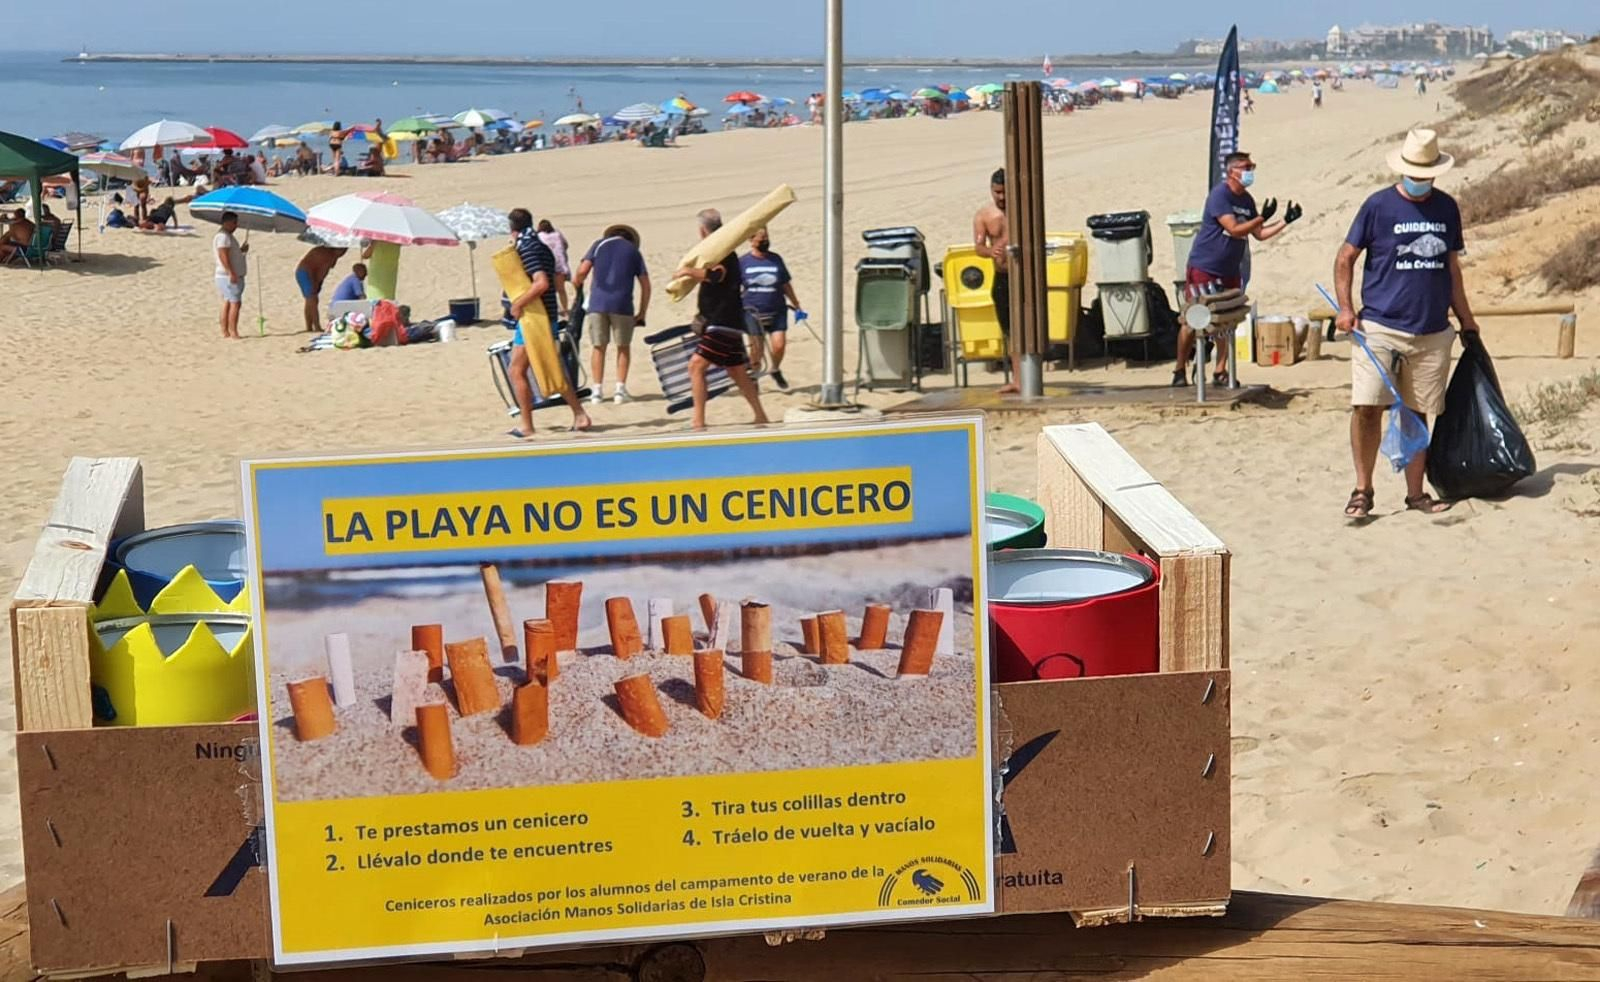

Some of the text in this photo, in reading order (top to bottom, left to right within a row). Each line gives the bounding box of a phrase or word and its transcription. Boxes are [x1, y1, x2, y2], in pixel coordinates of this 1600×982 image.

[1394, 222, 1447, 234] CUIDEMOS
[326, 480, 911, 543] LA PLAYA NO ES UN CENICERO
[681, 792, 906, 818] 3. Tira tus colillas dentro
[324, 811, 588, 843] 1. Te prestamos un cenicero
[682, 816, 935, 847] 4. Tráelo de vuelta y vacíalo
[325, 839, 613, 872] 2. Llévalo donde te encuentres
[895, 855, 962, 876] MANOS SOLIDARIAS
[385, 865, 884, 912] Ceniceros realizados por los alumnos del campamento de verano de la
[897, 895, 960, 906] Comedor Social
[484, 892, 792, 926] Asociación Manos Solidarias de Isla Cristina
